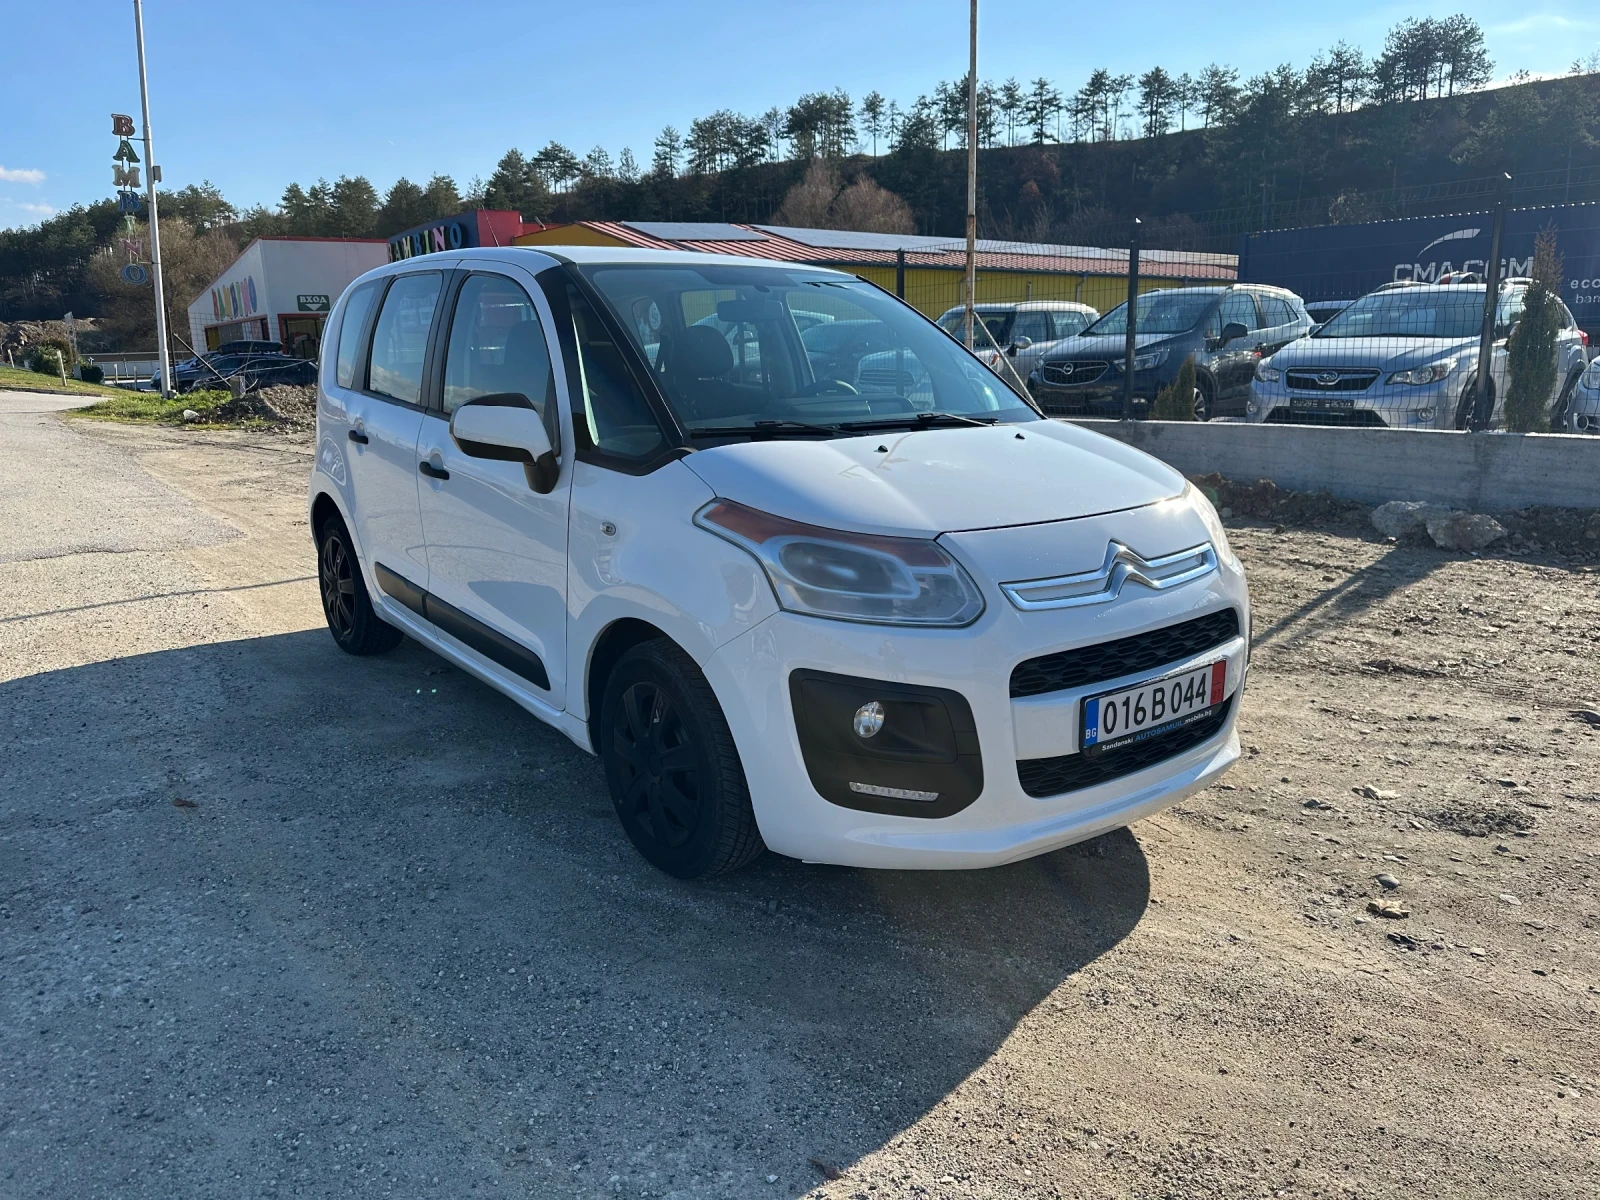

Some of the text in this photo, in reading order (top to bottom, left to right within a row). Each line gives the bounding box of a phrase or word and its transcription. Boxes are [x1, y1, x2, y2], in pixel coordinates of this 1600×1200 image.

[111, 113, 148, 285] BAMBINO
[387, 222, 463, 264] BAMBINO
[211, 275, 258, 321] BAMBINO
[1103, 672, 1207, 735] 016B044
[1085, 727, 1097, 740] BG
[1101, 737, 1134, 752] Sandanski
